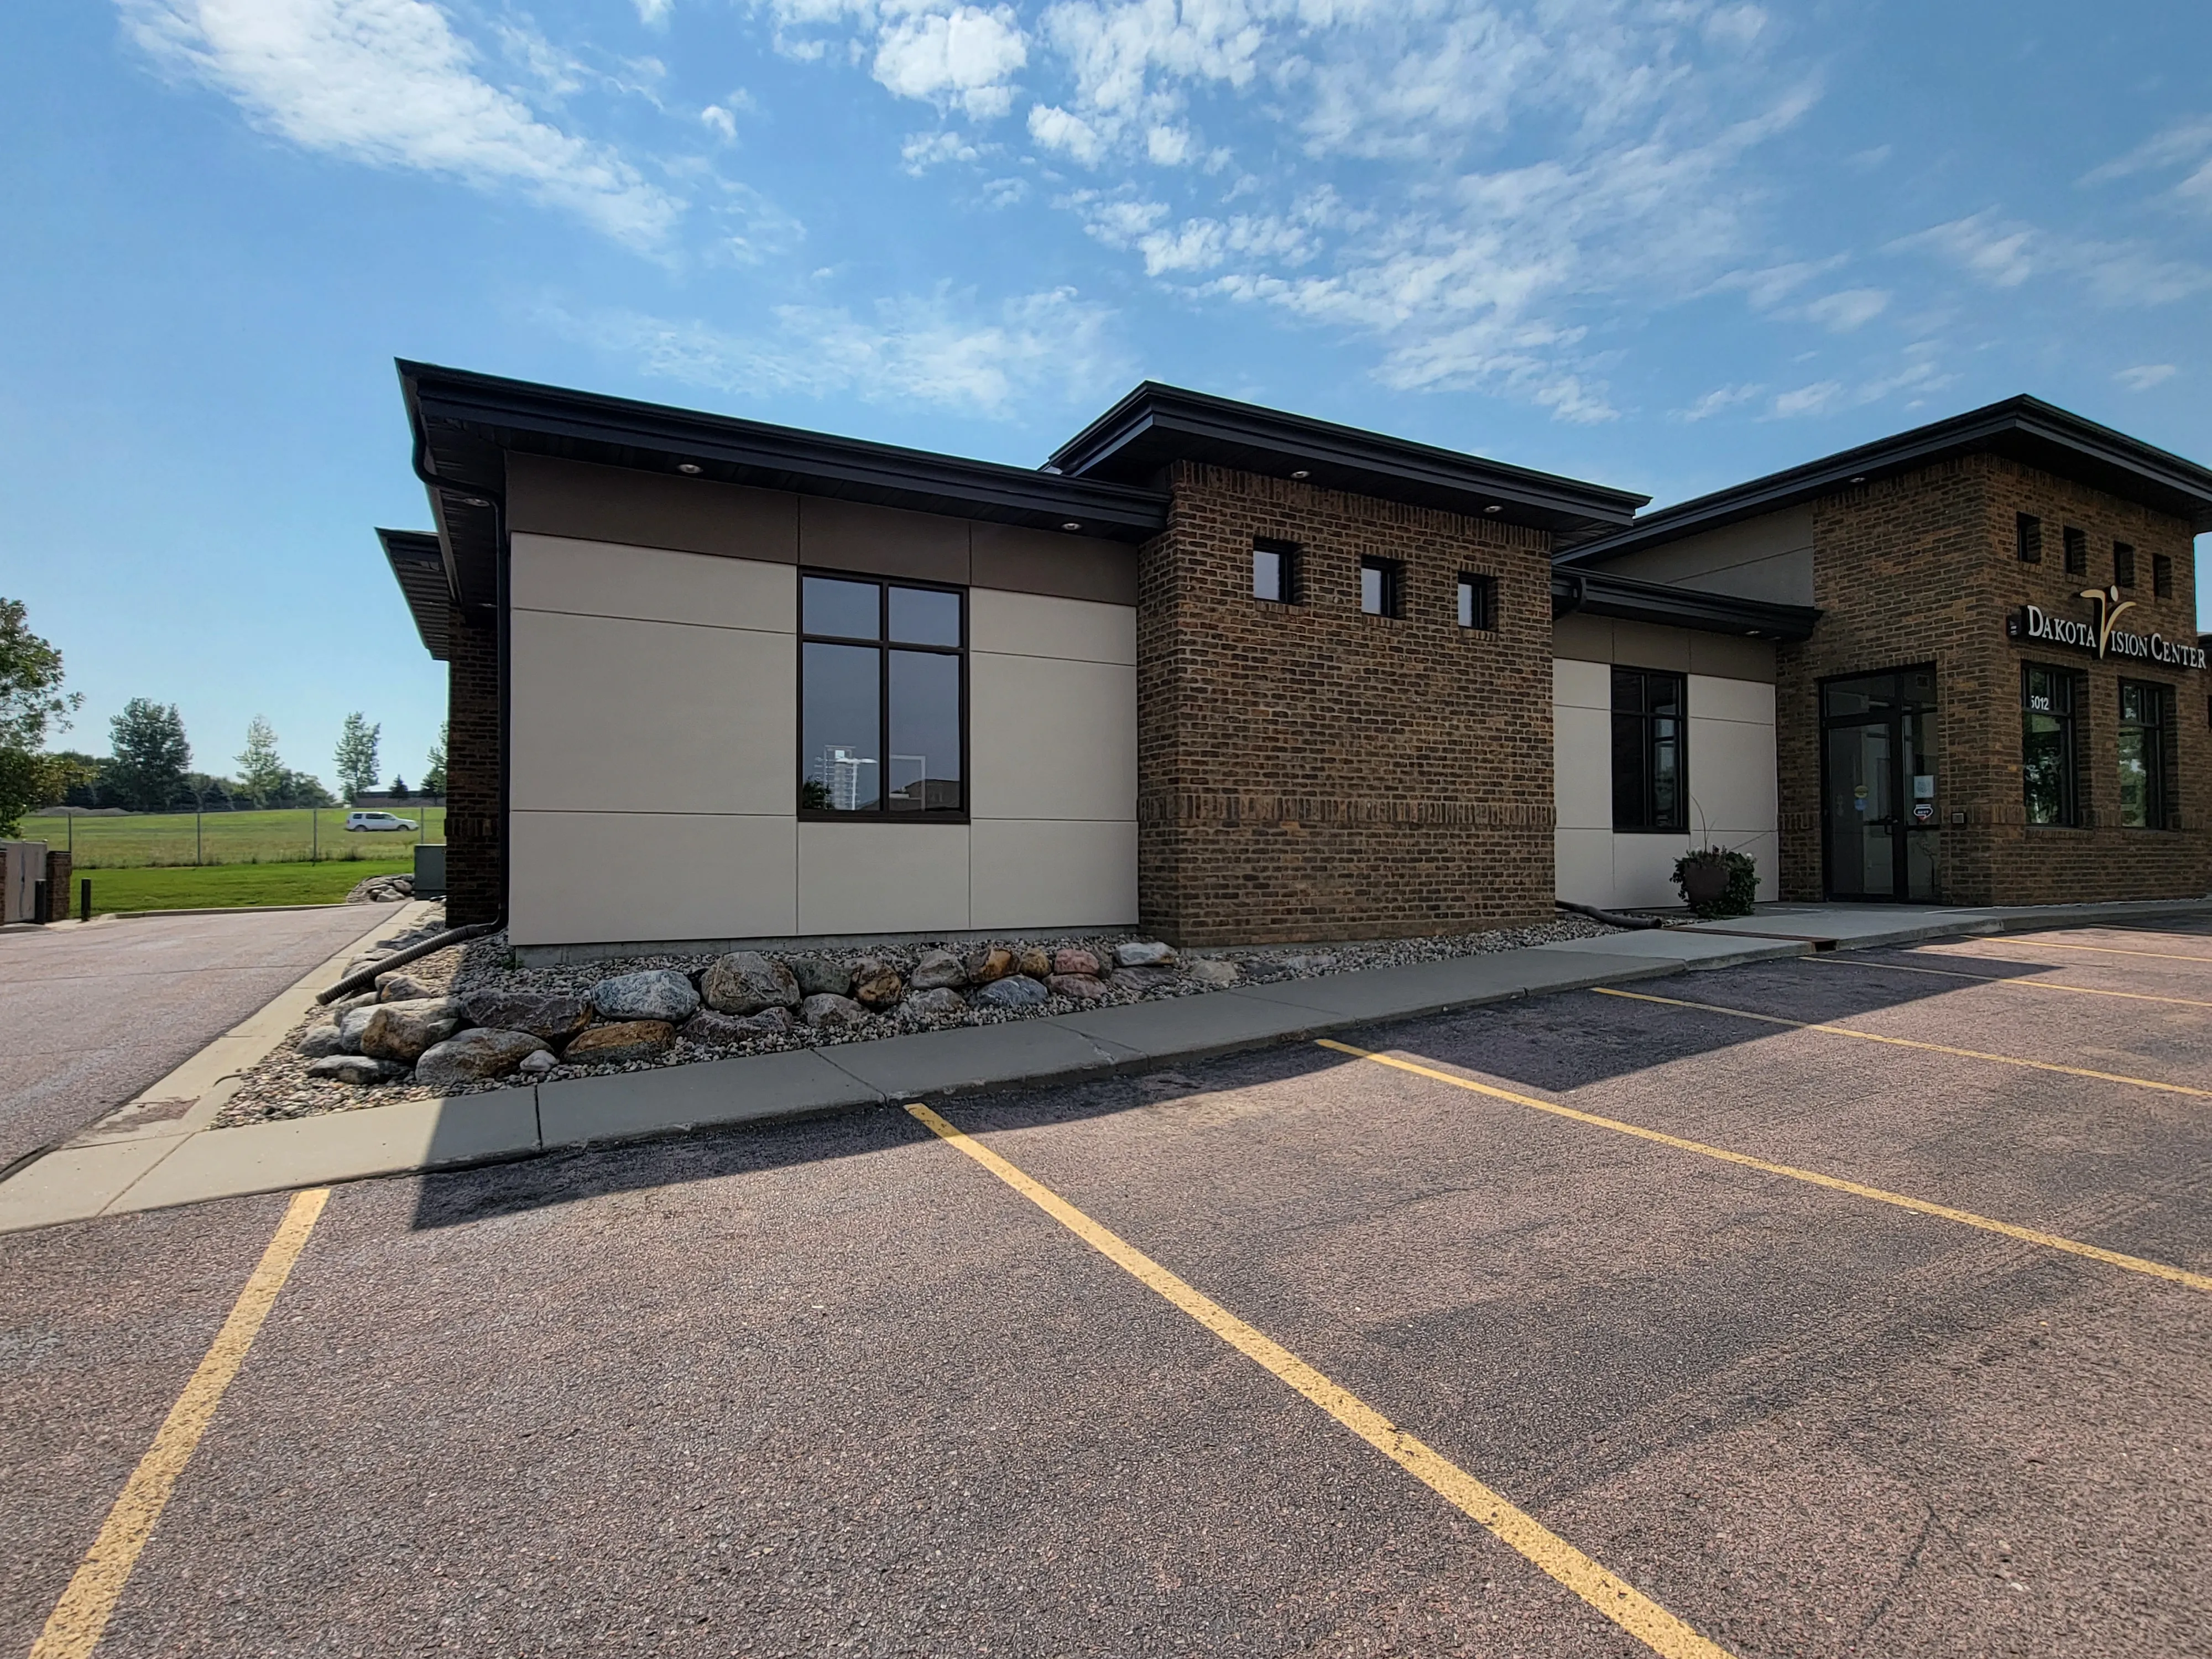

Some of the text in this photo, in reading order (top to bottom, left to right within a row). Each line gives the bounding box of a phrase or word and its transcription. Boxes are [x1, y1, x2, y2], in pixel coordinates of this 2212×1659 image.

[2027, 604, 2096, 648] DAKOTA
[2151, 633, 2206, 669] CENTER
[2031, 695, 2049, 710] 5012
